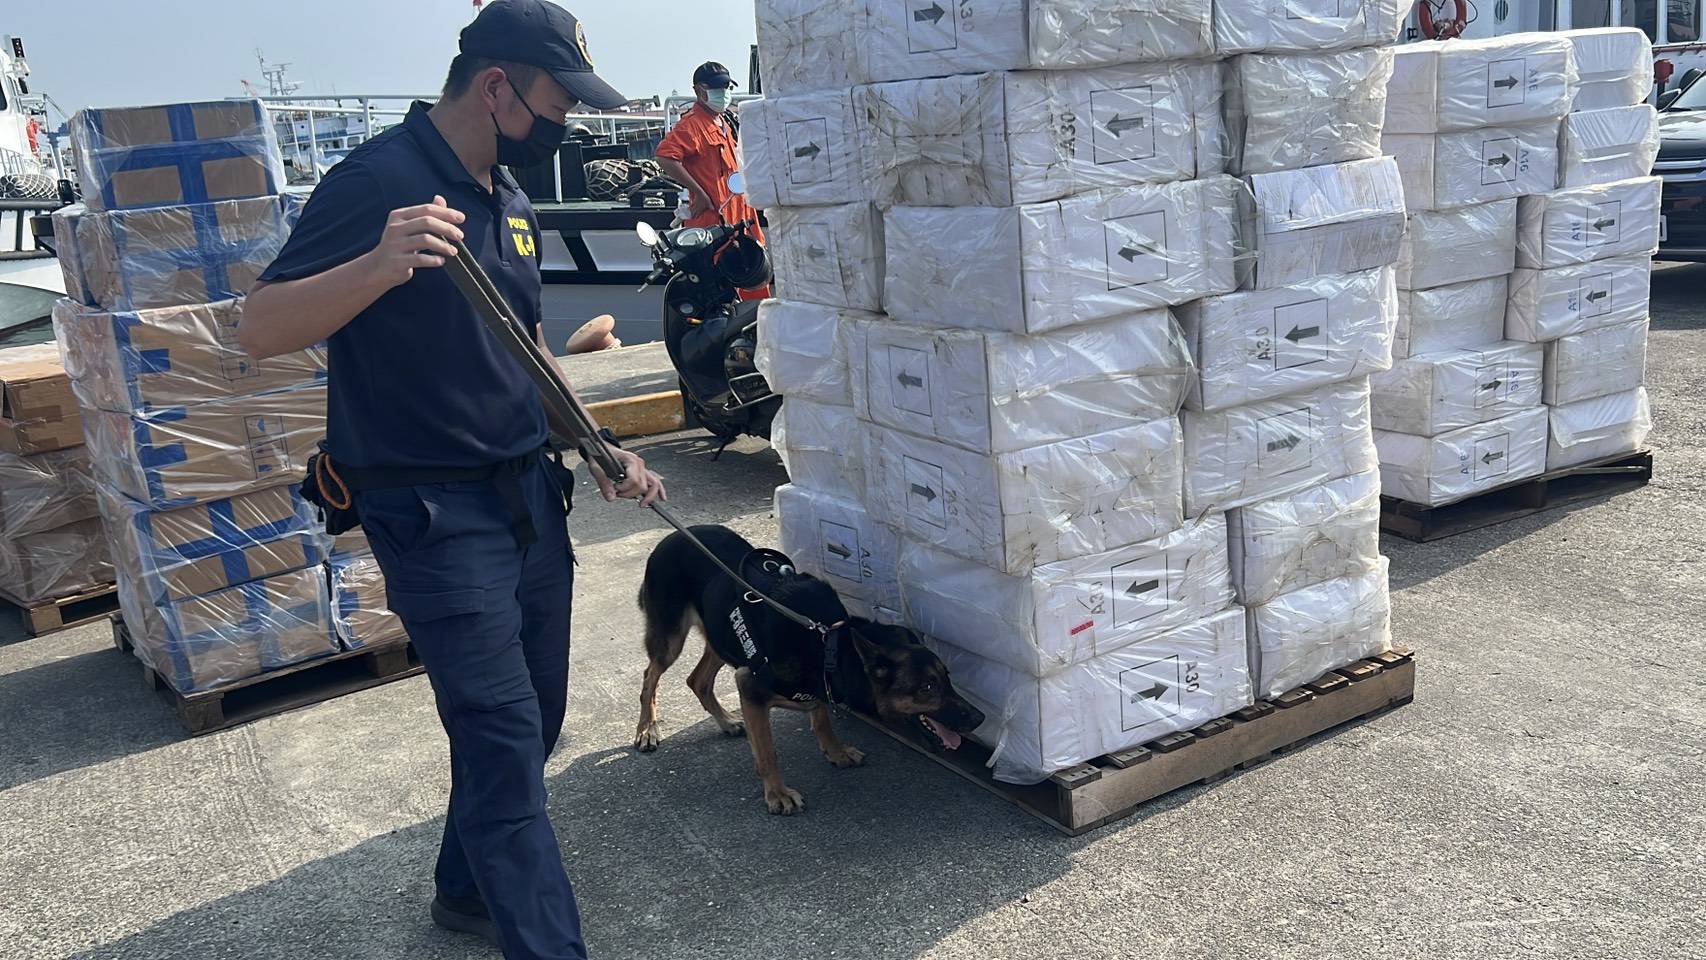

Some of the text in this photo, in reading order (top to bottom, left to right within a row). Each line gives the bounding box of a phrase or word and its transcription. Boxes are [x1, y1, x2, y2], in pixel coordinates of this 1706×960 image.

[960, 0, 975, 32] 30
[1520, 150, 1529, 172] A16
[1255, 326, 1272, 361] A30
[1185, 661, 1200, 693] A30
